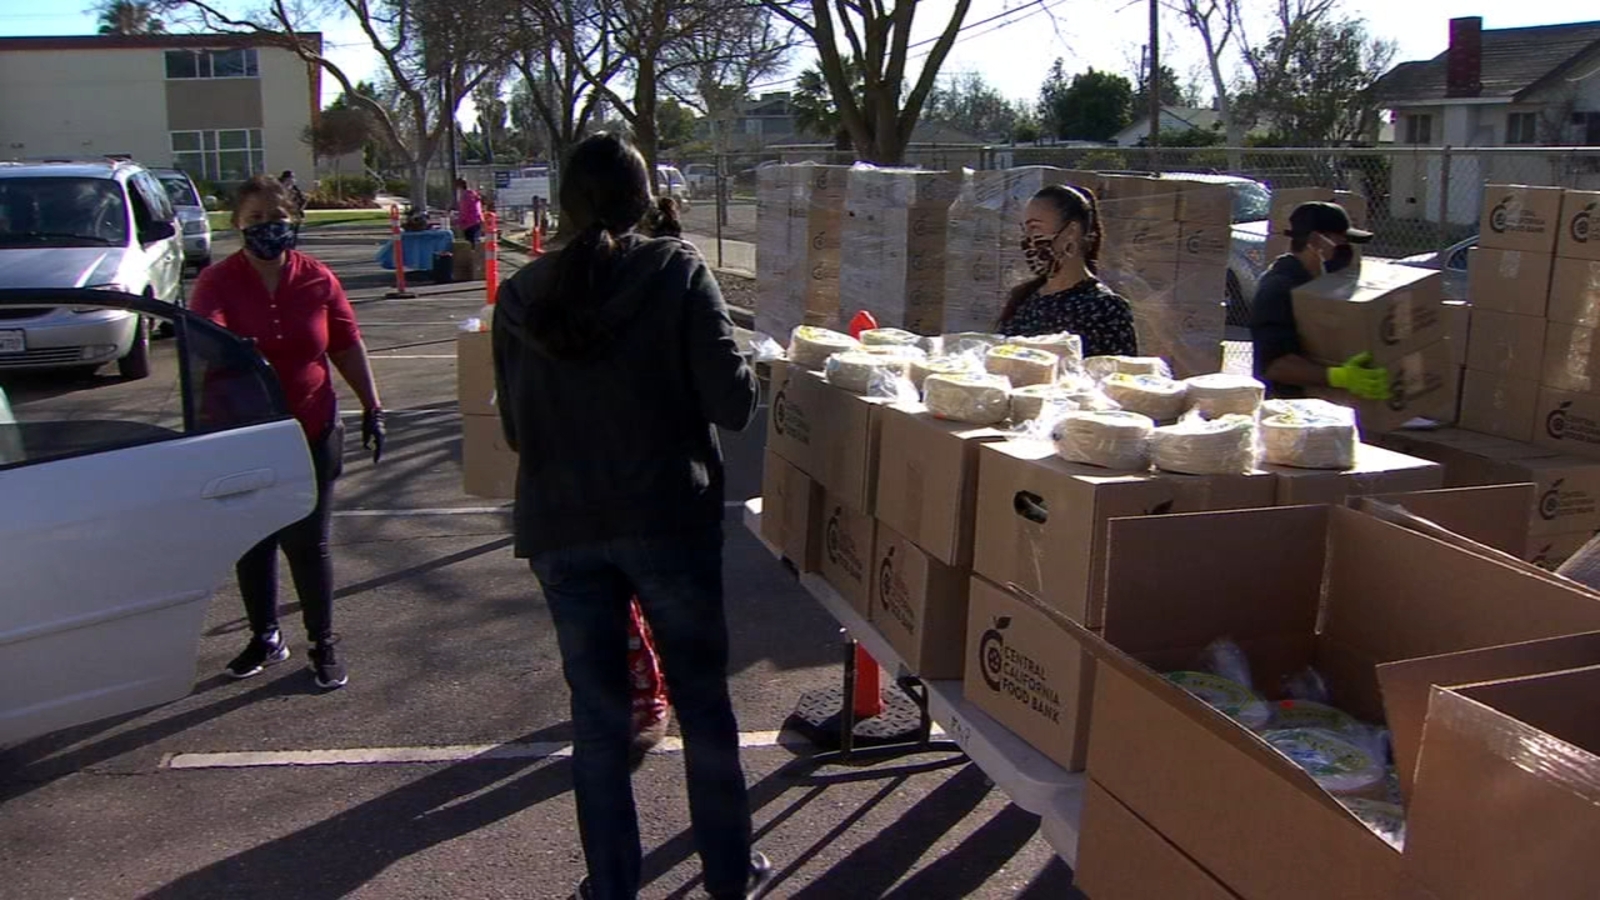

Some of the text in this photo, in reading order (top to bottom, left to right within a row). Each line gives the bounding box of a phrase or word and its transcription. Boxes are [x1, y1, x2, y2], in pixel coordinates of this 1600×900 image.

[1003, 661, 1060, 705] CALIFORNIA
[1004, 645, 1047, 681] CENTRAL
[1002, 677, 1060, 725] FOOD BANK
